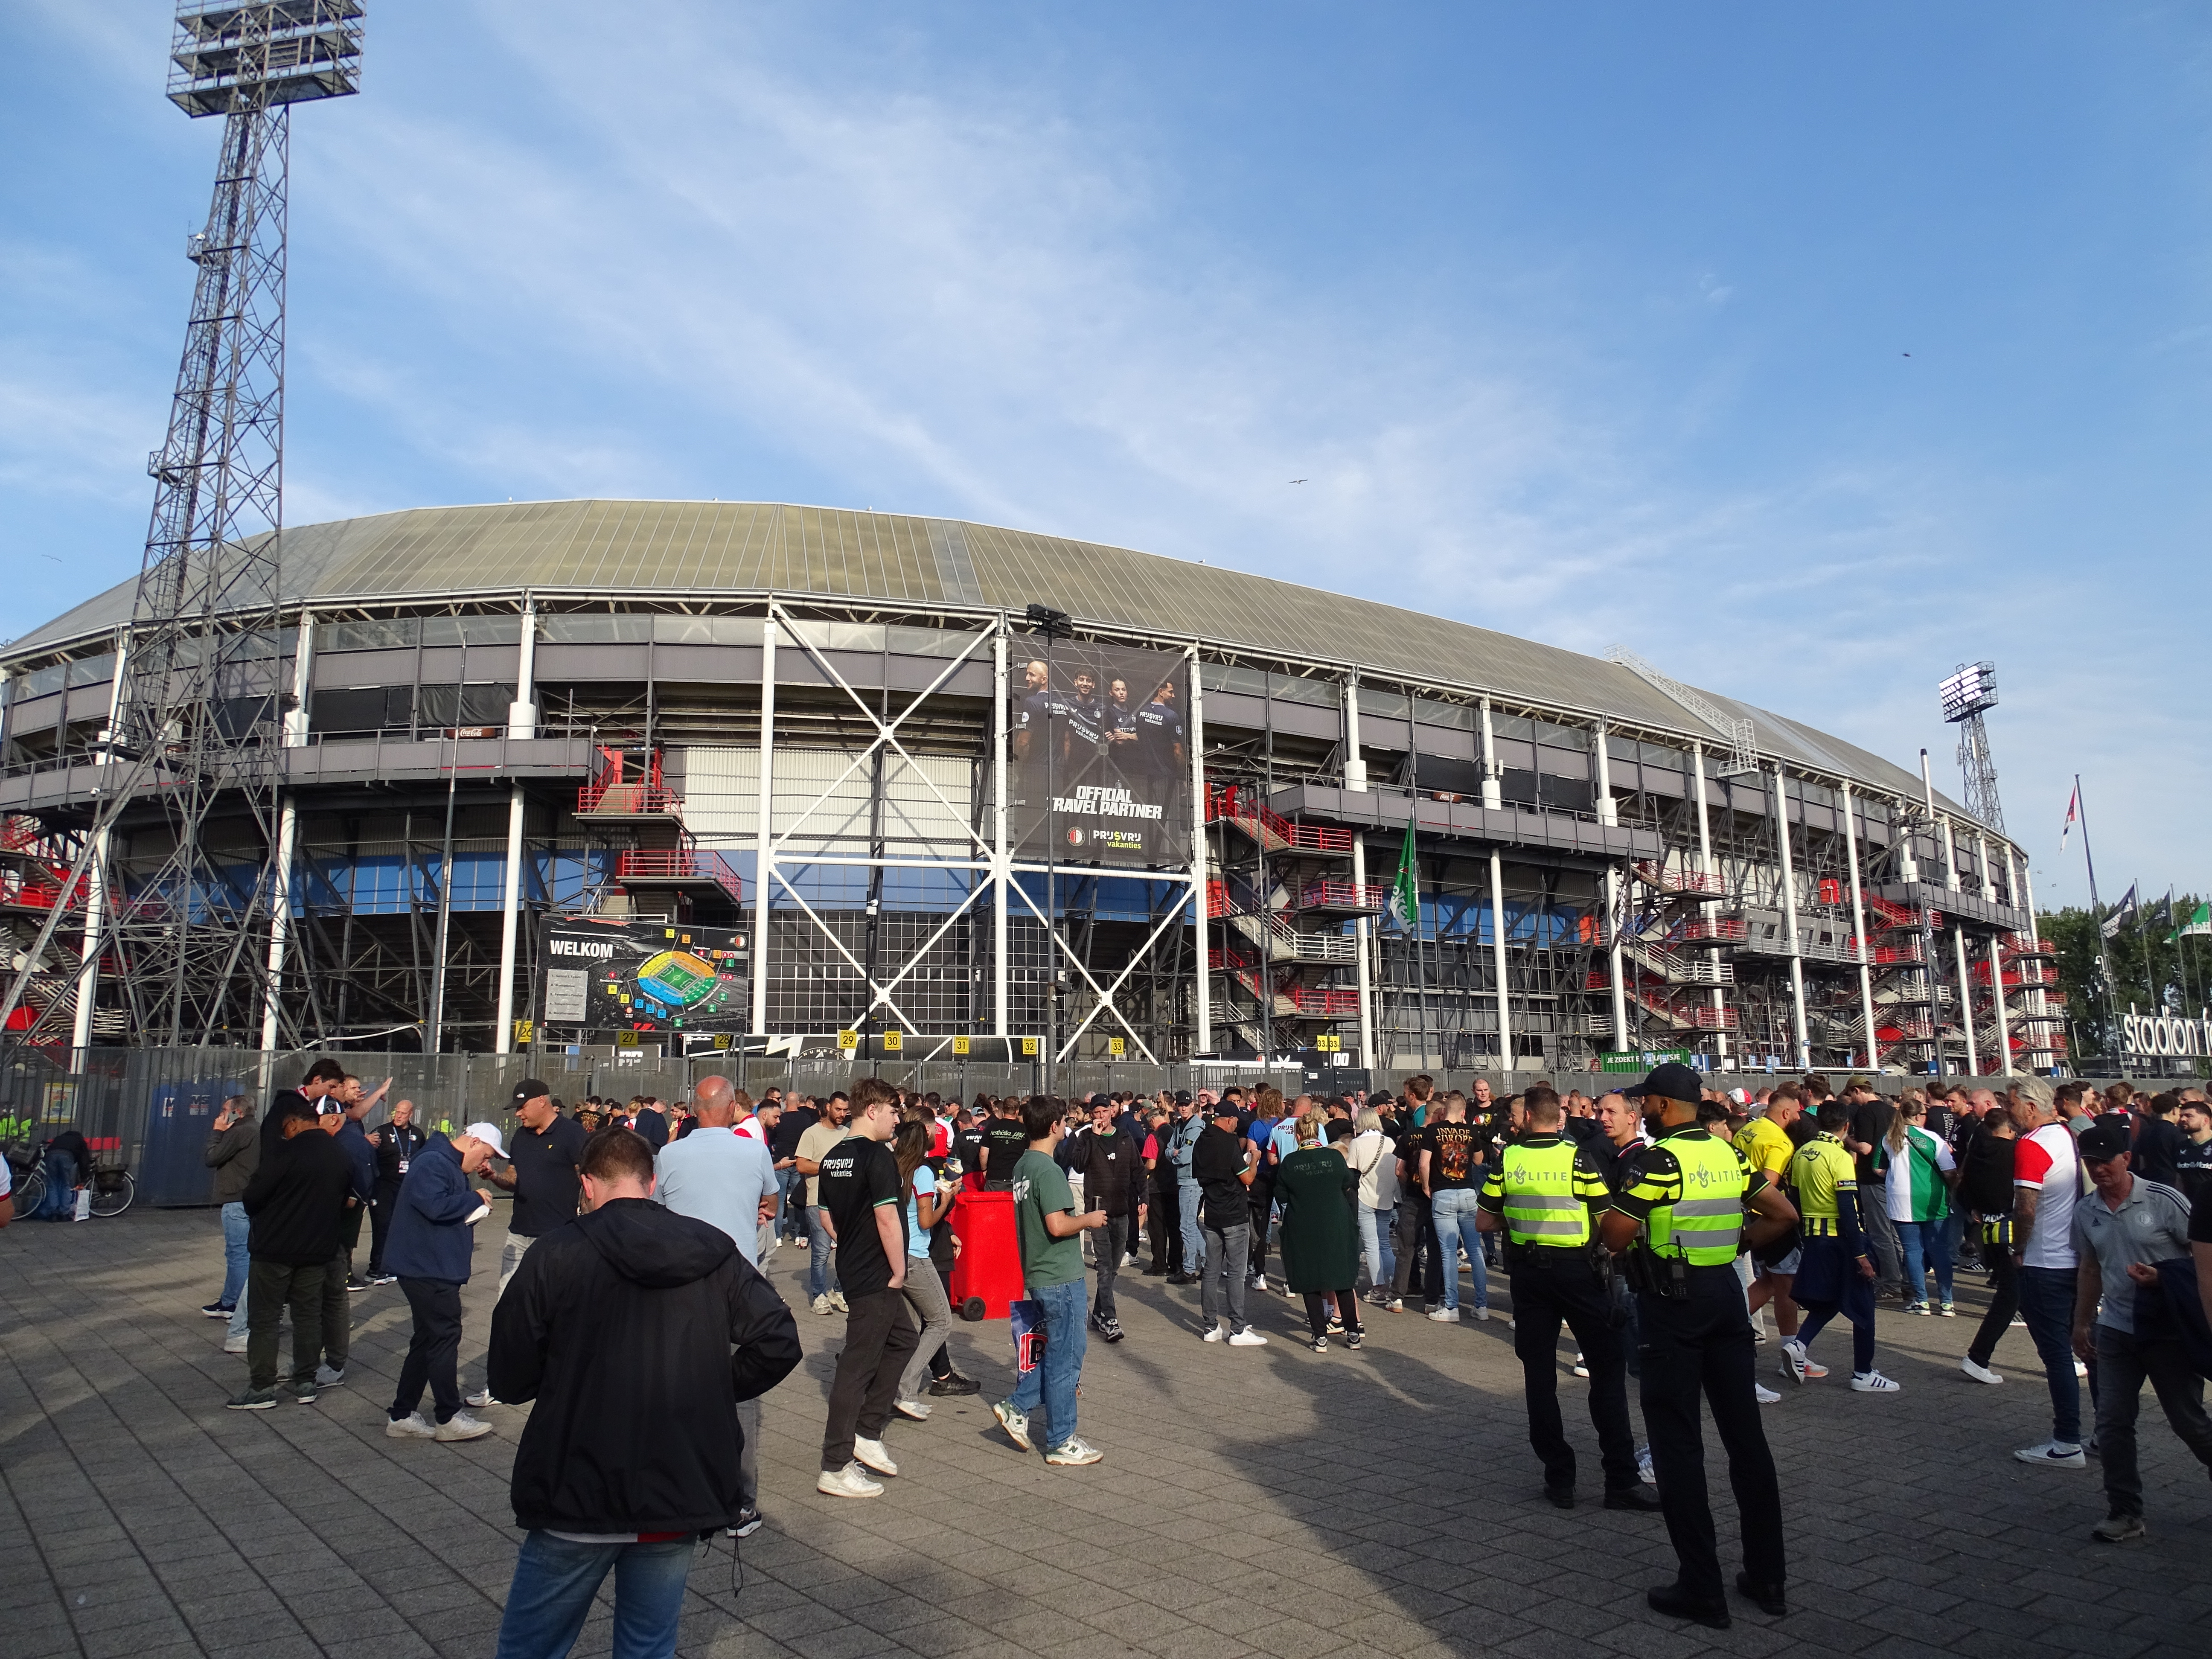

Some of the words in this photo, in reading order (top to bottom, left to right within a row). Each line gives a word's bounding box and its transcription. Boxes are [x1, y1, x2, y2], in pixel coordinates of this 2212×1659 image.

[1075, 729, 1097, 744] vakanties
[1076, 786, 1132, 803] OFFICIAL
[1046, 797, 1097, 815] RAVEL
[1099, 801, 1162, 819] PARTNER
[1107, 841, 1141, 849] vakanties
[550, 940, 613, 958] WELKOM
[2124, 1002, 2200, 1055] stadion
[623, 1033, 634, 1042] 27
[719, 1034, 729, 1044] 28
[843, 1036, 853, 1044] 29
[888, 1037, 897, 1045] 30
[957, 1041, 965, 1049] 31
[1435, 1135, 1473, 1144] EUROPE
